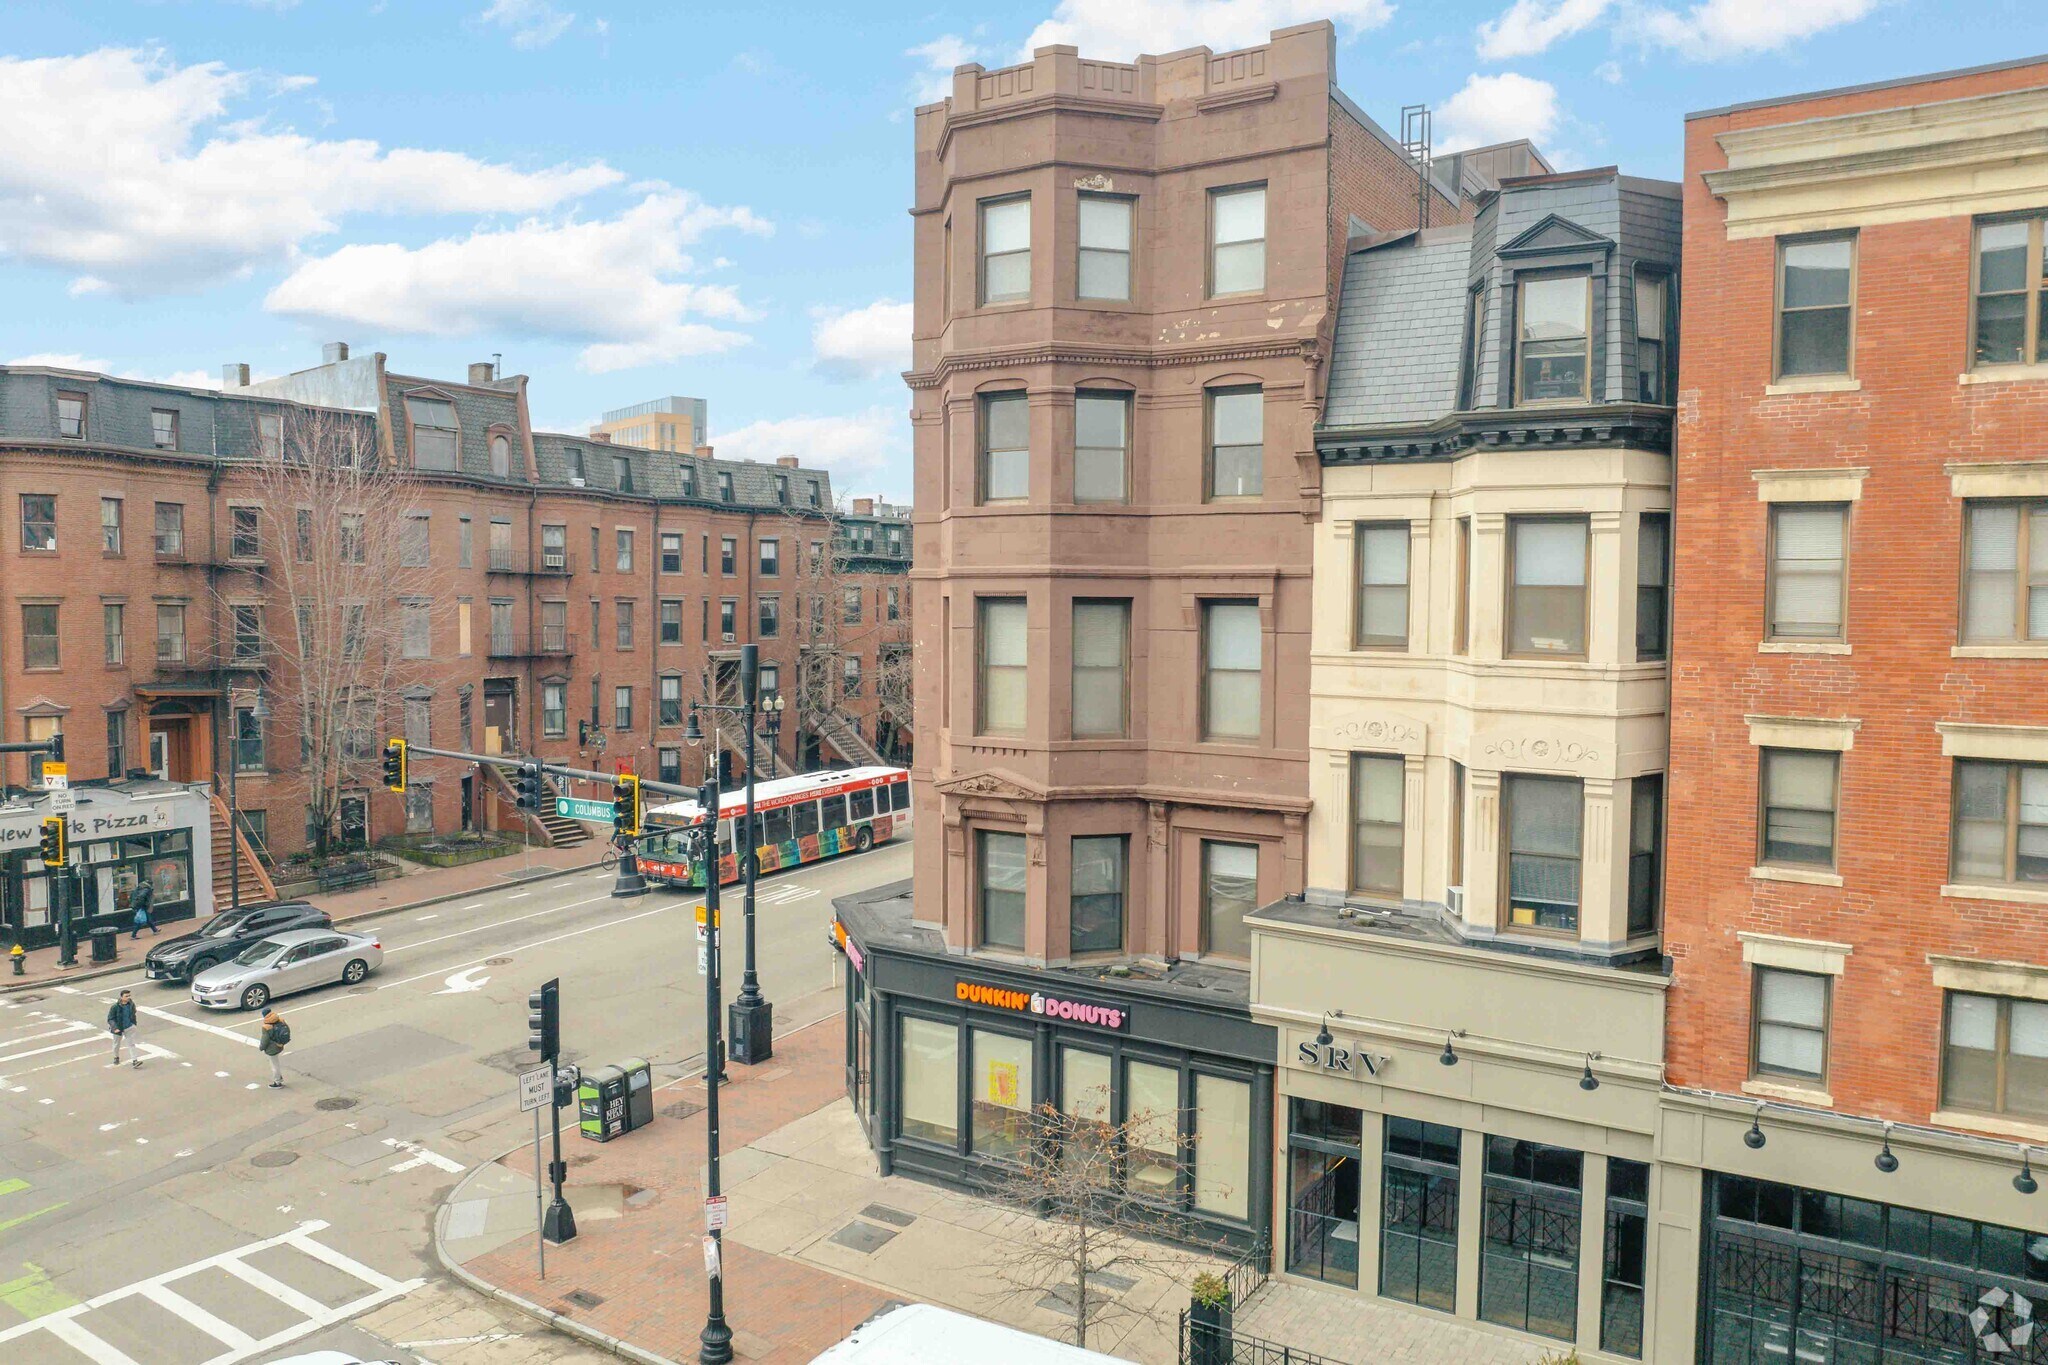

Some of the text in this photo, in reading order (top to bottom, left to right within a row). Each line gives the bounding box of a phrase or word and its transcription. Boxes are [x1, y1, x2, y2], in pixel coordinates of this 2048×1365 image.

[574, 804, 611, 818] COLUMBUS
[956, 982, 1122, 1028] DUNKIN' DONUTS
[1298, 1041, 1391, 1076] SRV
[523, 1070, 549, 1085] LEFT LANE
[528, 1082, 545, 1094] MUST
[524, 1092, 550, 1106] TURN LEFT
[609, 1095, 624, 1109] HEY
